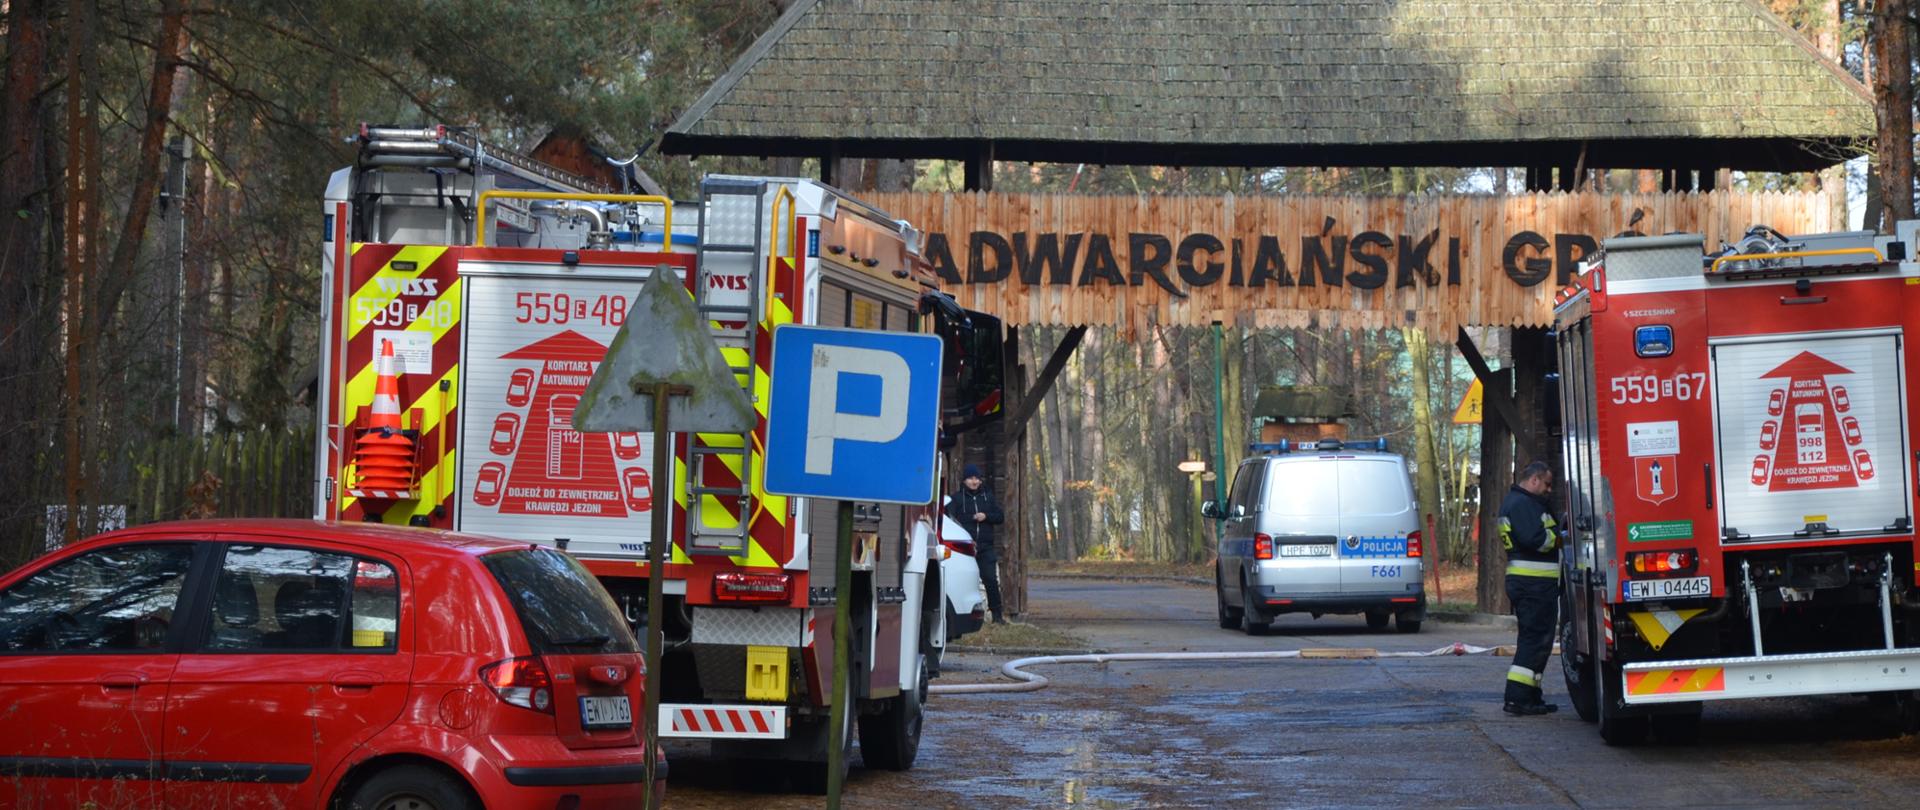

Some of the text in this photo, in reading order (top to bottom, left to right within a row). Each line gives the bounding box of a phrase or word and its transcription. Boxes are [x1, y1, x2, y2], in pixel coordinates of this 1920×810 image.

[375, 277, 438, 296] WISS
[547, 361, 589, 372] KORYTARZ
[542, 374, 592, 386] RATUNKOWY
[804, 343, 911, 476] P
[562, 430, 580, 444] 112
[1799, 436, 1823, 448] 998
[1801, 451, 1824, 462] 112
[508, 486, 619, 502] DOJEDŹ DO ZEWNĘTRZNEJ
[525, 501, 601, 514] KRAWĘDZI JEZDNI
[1362, 542, 1403, 553] POLICJA
[1371, 565, 1401, 578] F661
[1630, 578, 1709, 598] EWI 04445
